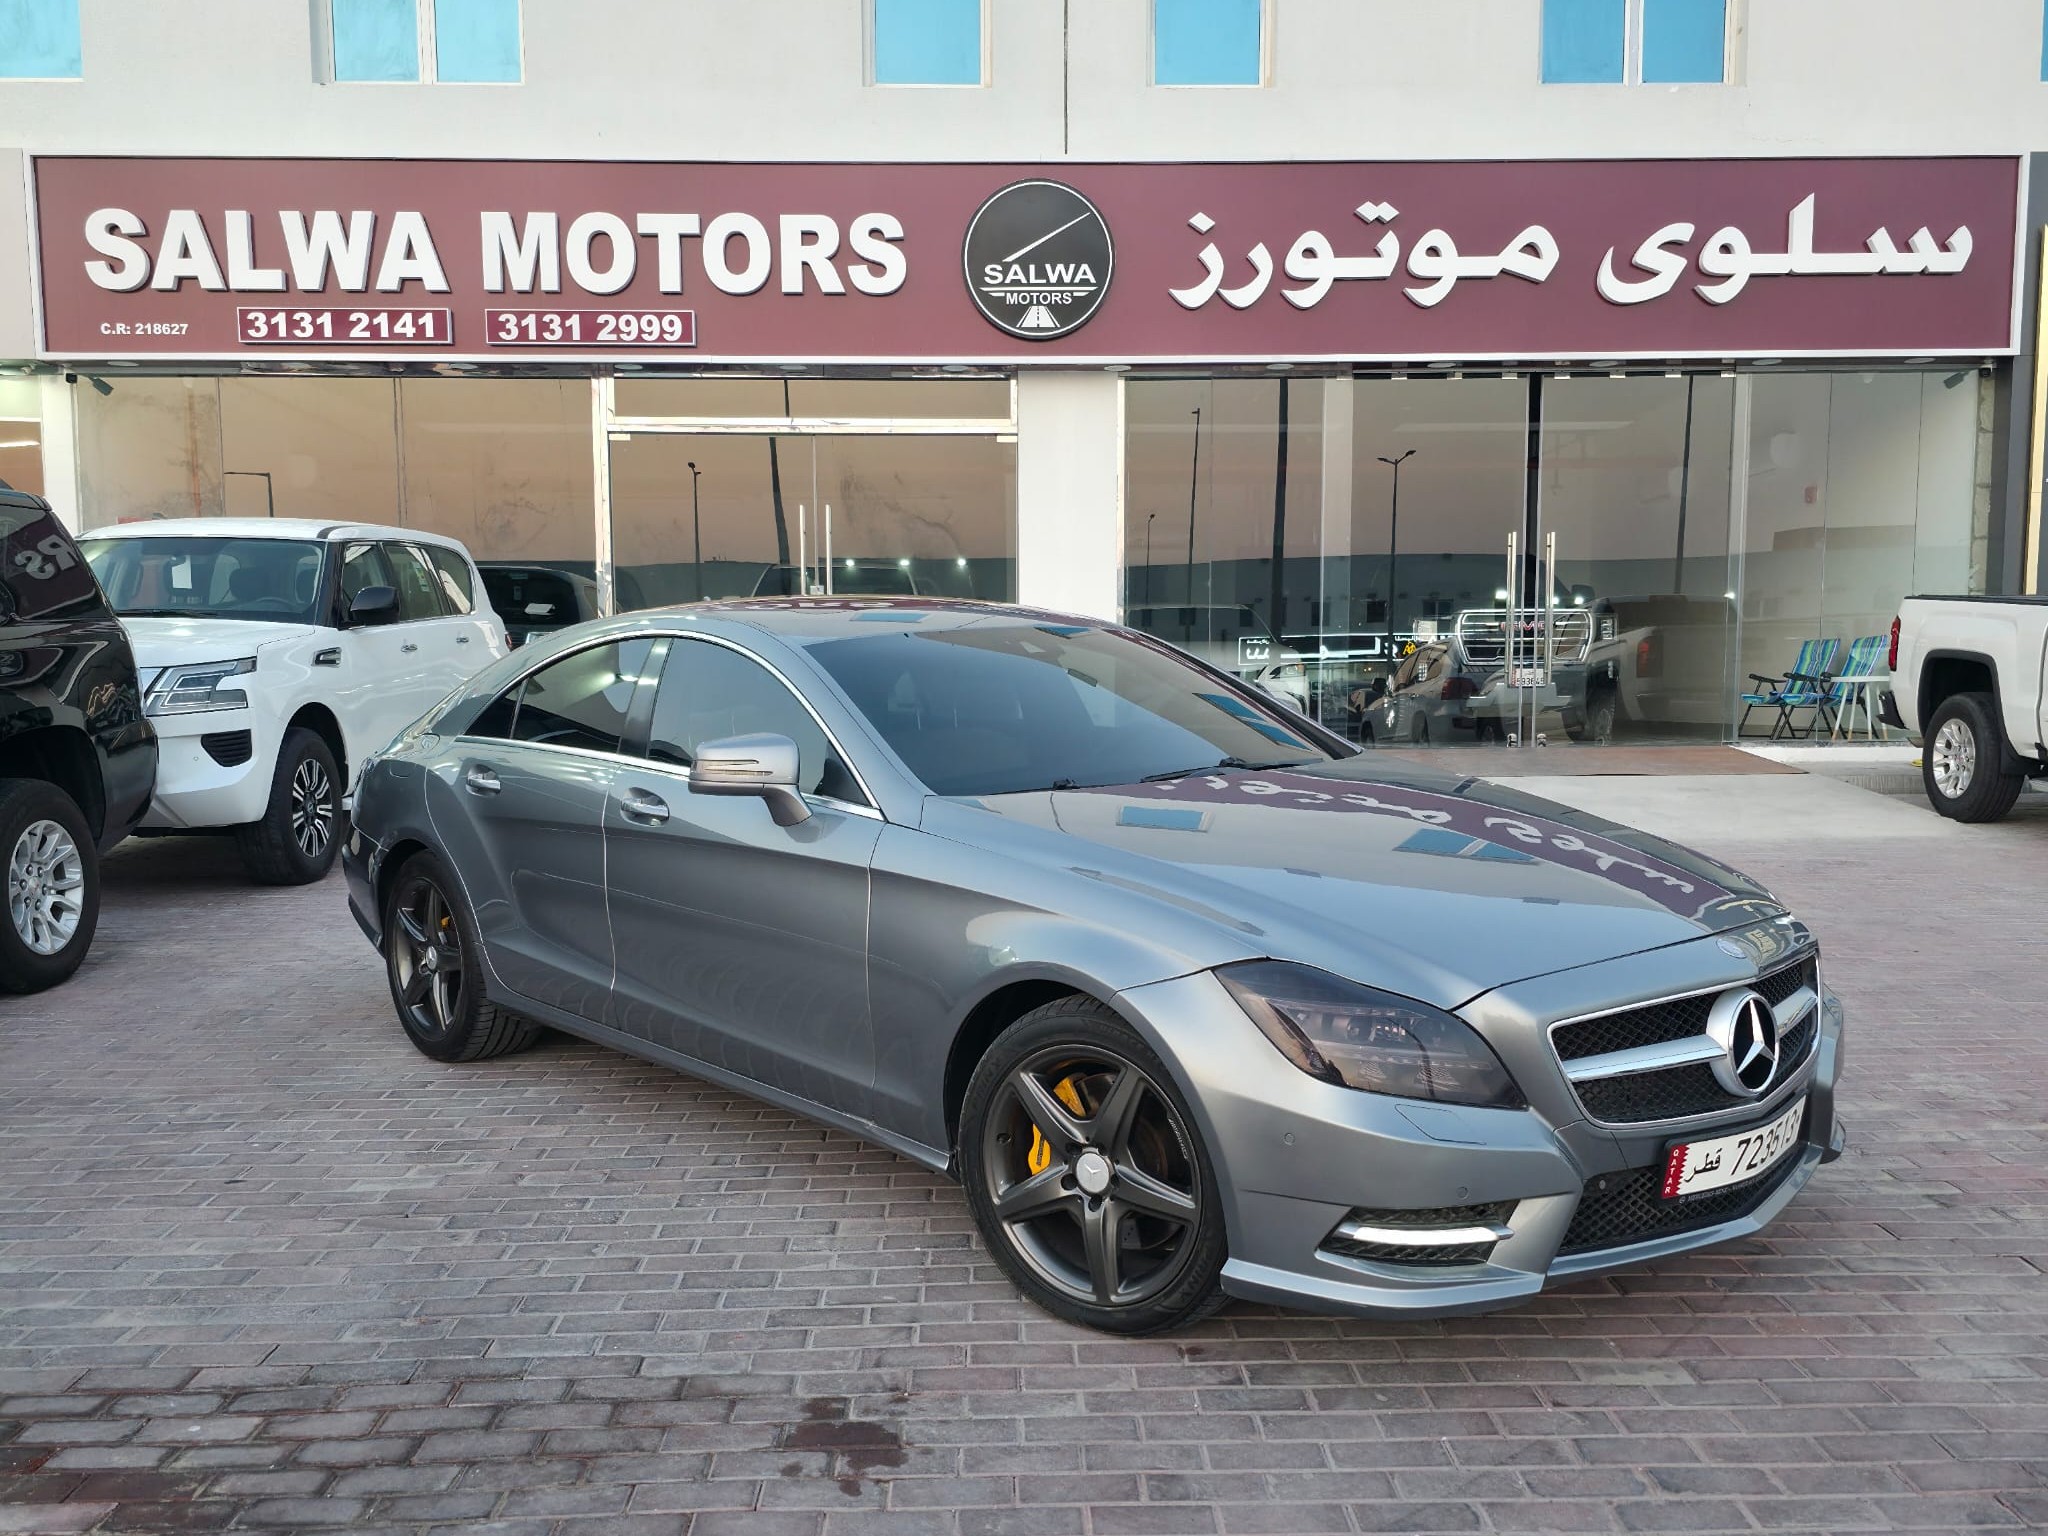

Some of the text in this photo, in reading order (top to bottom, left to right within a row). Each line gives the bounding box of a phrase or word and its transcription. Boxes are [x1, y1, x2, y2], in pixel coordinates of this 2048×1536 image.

[84, 207, 907, 295] SALWA MOTORS
[1168, 193, 1973, 308] سلوى موتورز
[983, 263, 1096, 285] SALWA
[1005, 291, 1073, 306] MOTORS
[100, 322, 189, 336] C.R: 218627
[246, 311, 434, 338] 3131 2141
[498, 313, 683, 342] 3131 2999
[1664, 1148, 1680, 1195] QATAR
[1683, 1147, 1723, 1183] قطر
